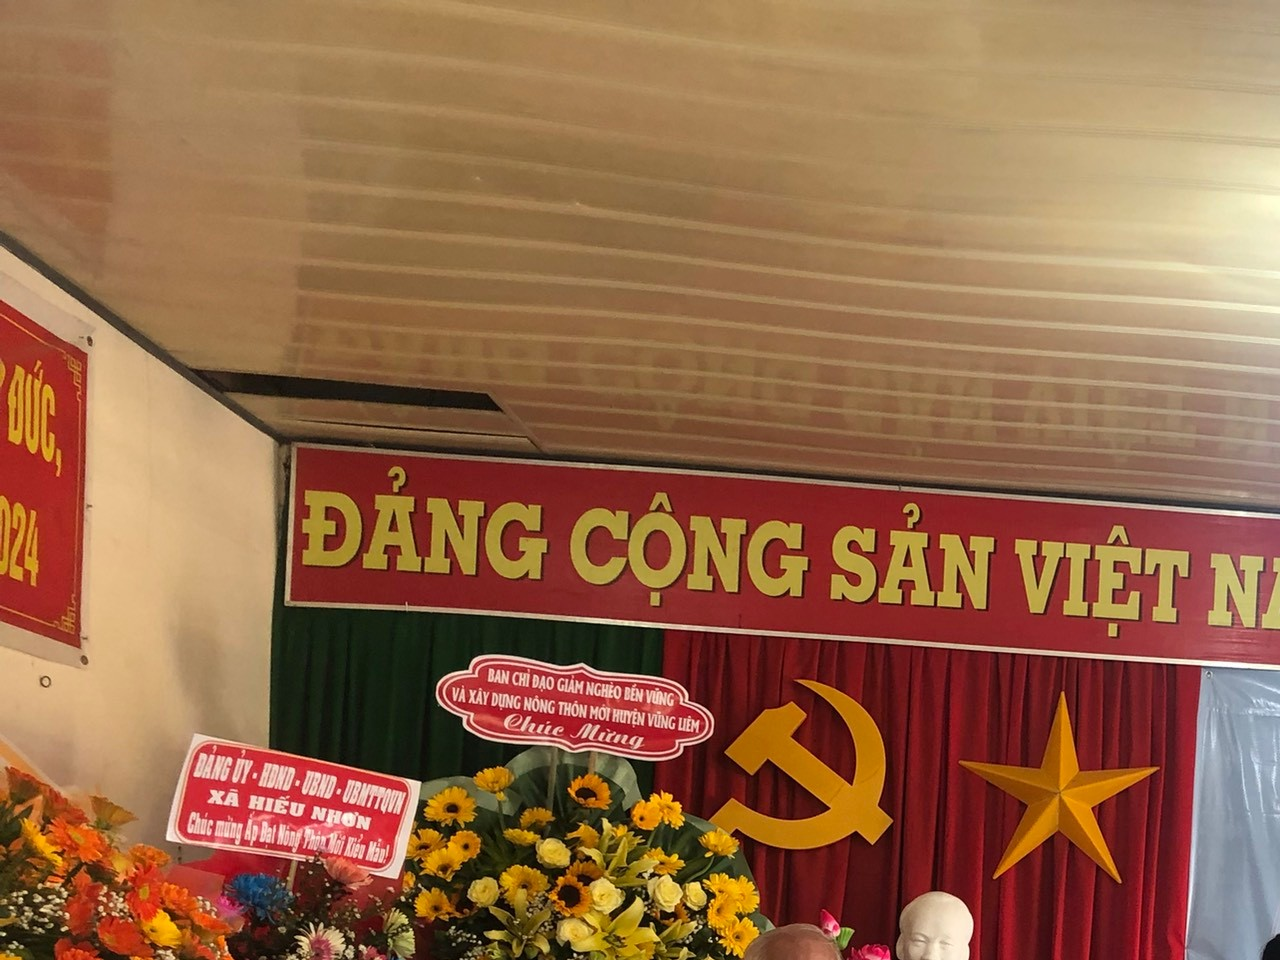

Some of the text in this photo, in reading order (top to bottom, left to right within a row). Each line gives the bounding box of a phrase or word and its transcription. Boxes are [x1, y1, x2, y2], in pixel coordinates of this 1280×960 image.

[8, 360, 61, 477] ĐỨC,
[302, 466, 548, 580] ĐẢNG
[570, 492, 809, 607] CỘNG
[830, 503, 995, 611] SẢN
[1014, 525, 1190, 637] VIỆT
[452, 686, 700, 734] VÀ XÂY DỰNG NÔNG THÔN MỚI HUYỆN VŨNG LIÊM
[487, 668, 675, 707] BAN CHỈ ĐẠO GIẢM NGHÈO BỀN VỮNG
[503, 713, 646, 750] Chúc Mừng
[193, 745, 233, 782] ĐẢNG
[232, 750, 254, 784] ỦY
[302, 771, 337, 800] UBND
[187, 811, 214, 837] Chúc
[207, 788, 372, 830] XÃ HIẾU NHƠN
